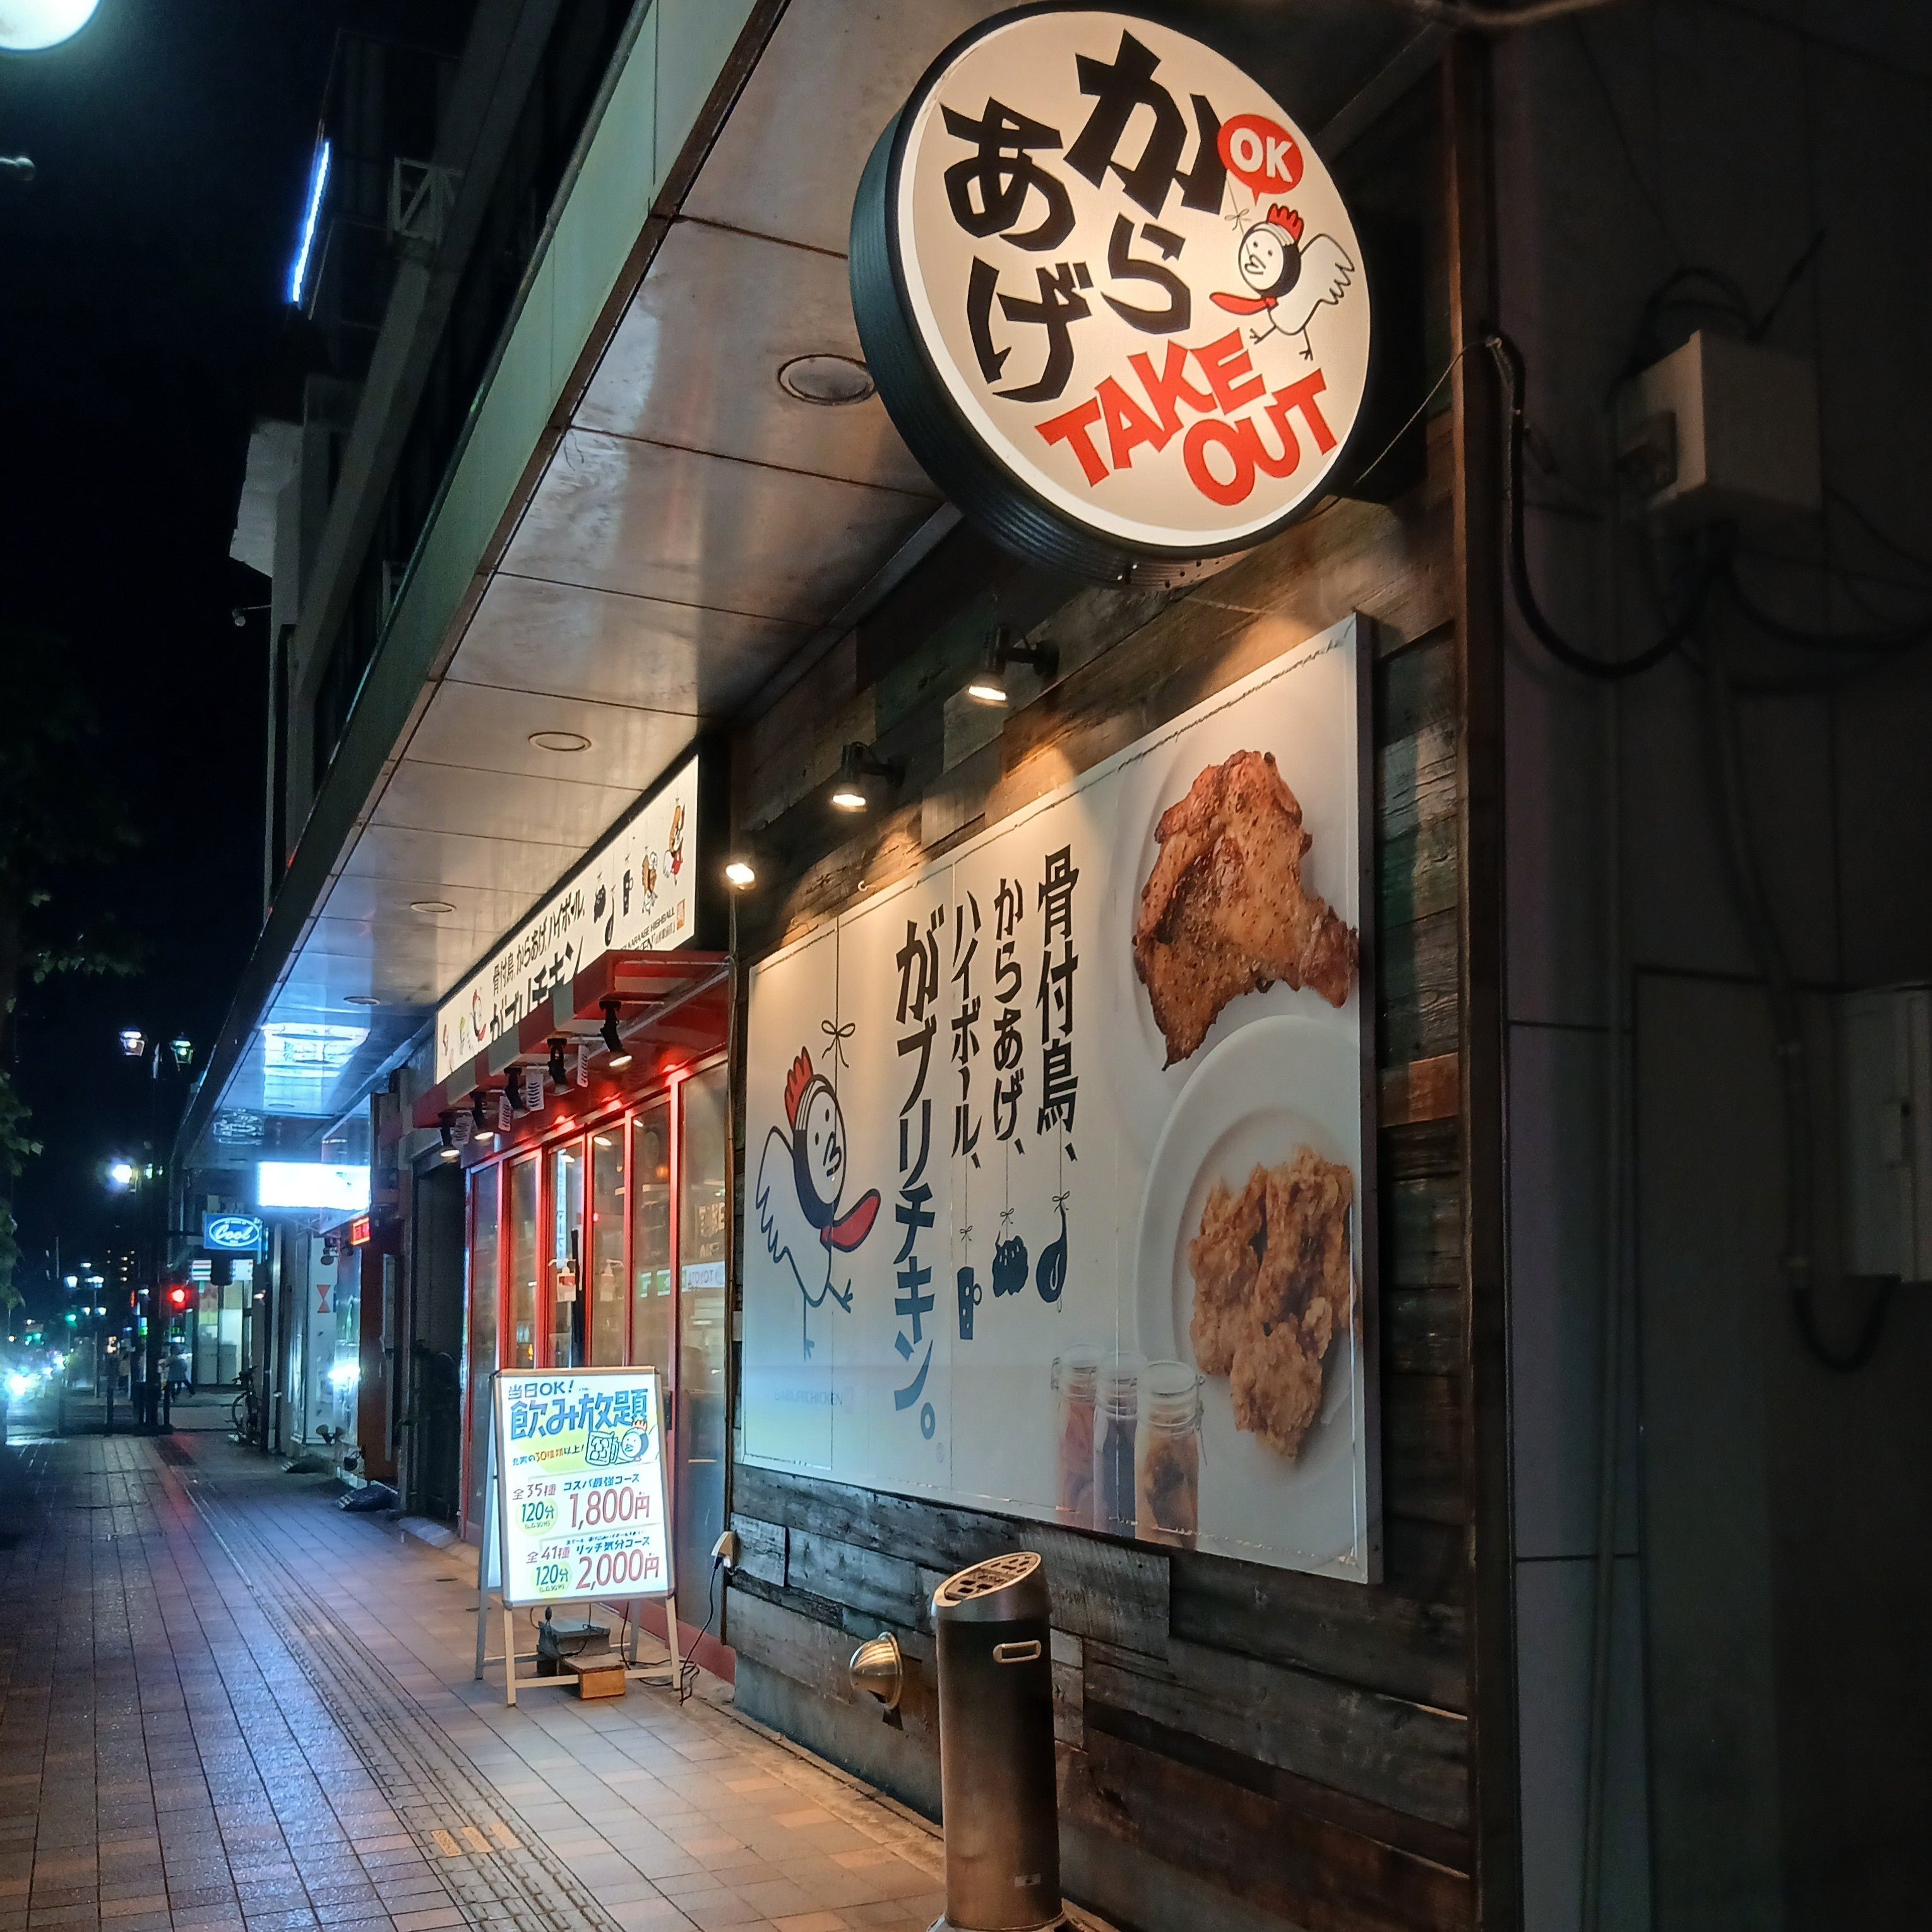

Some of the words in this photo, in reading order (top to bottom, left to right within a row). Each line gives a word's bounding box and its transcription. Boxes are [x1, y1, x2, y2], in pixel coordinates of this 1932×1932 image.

[1229, 132, 1293, 184] OK
[1035, 328, 1265, 487] TAKE
[1183, 368, 1339, 506] OUT
[215, 1224, 253, 1240] Cool
[510, 1388, 648, 1440] 飲み放題
[522, 1501, 554, 1522] 120分
[569, 1486, 650, 1530] 1,800円
[536, 1564, 569, 1587] 120分
[575, 1549, 659, 1590] 2,000円
